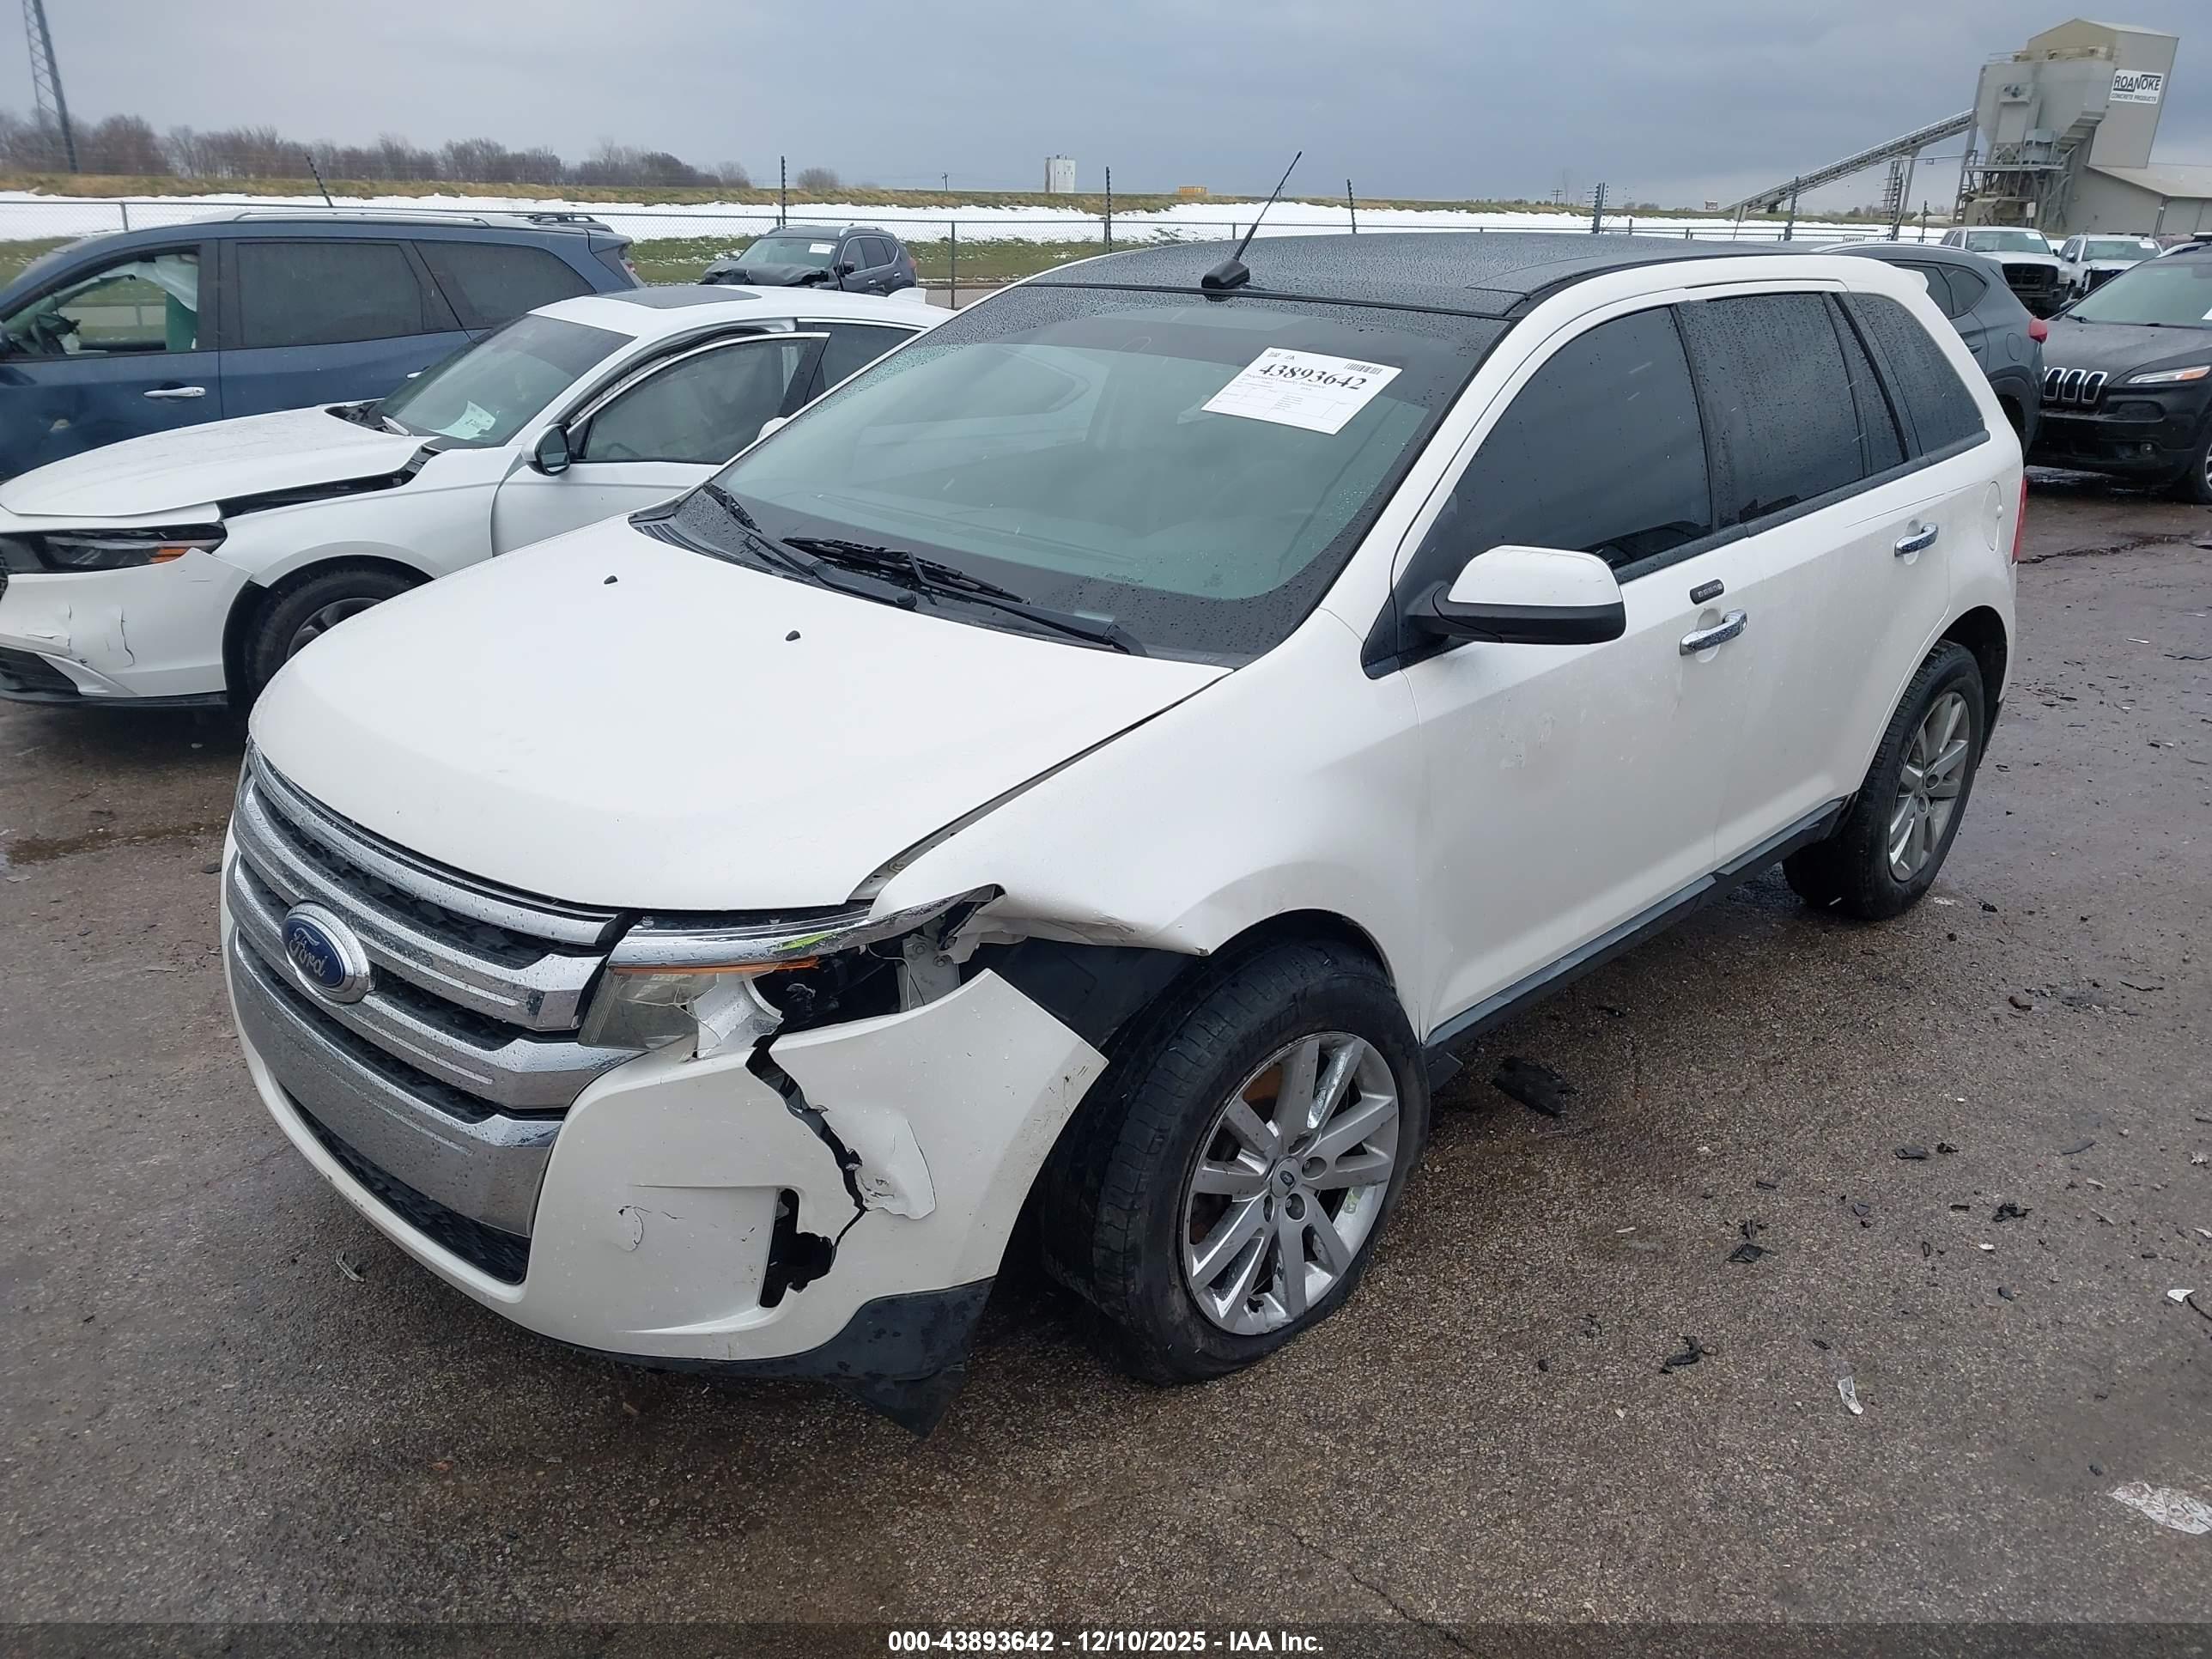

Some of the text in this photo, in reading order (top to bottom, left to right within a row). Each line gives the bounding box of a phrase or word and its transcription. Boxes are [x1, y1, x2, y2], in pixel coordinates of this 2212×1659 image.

[2113, 75, 2161, 92] ROANOKE
[1259, 364, 1367, 390] 43893642
[289, 927, 328, 977] Ford
